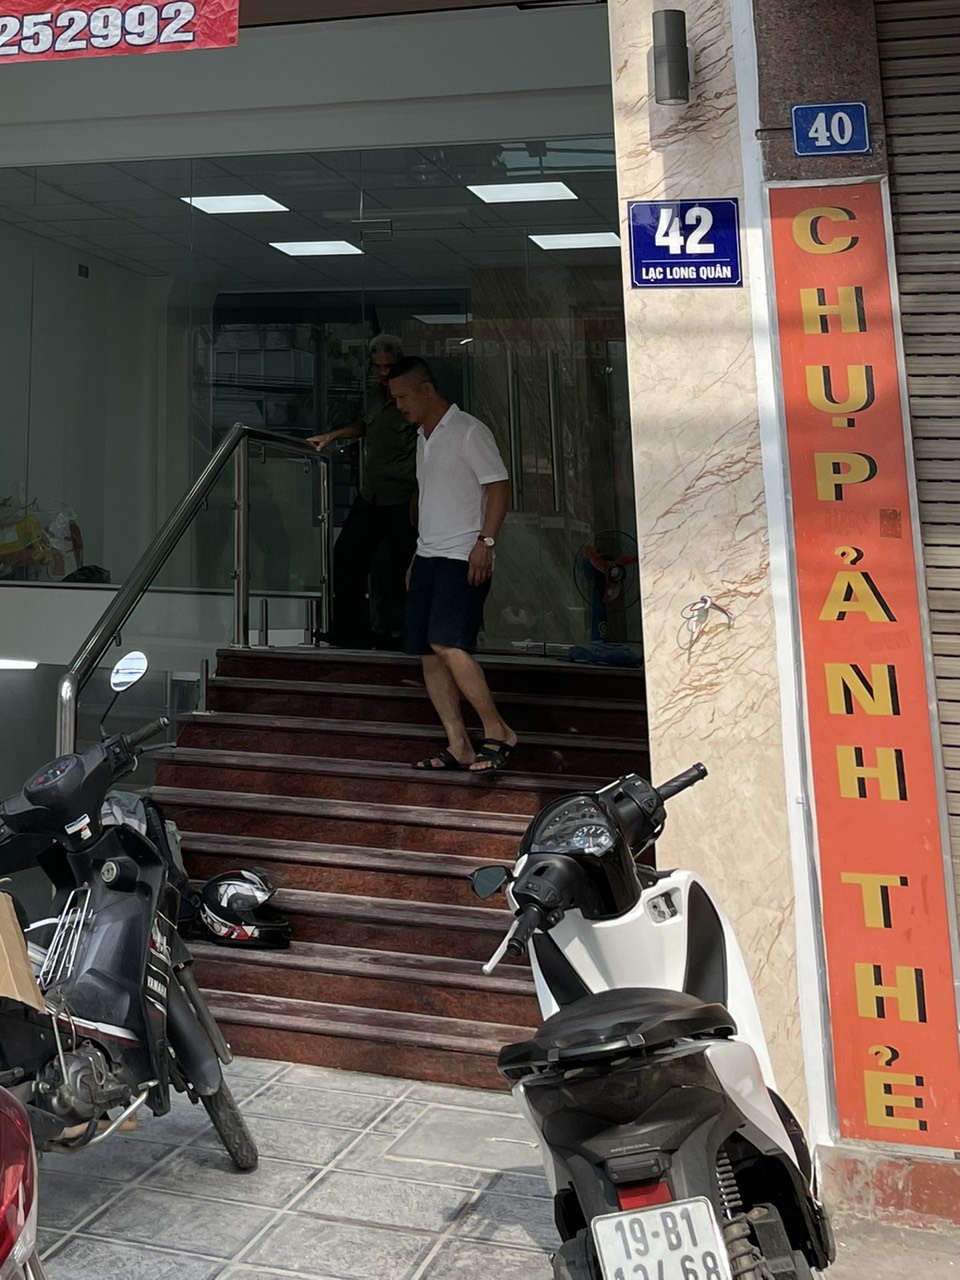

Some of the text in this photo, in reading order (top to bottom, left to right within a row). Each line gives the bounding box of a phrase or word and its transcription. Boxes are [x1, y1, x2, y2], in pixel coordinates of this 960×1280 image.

[807, 111, 853, 147] 40
[642, 263, 732, 282] LẠC LONG QUÂN
[654, 206, 716, 255] 42
[792, 206, 878, 501] CHỤP
[819, 546, 908, 801] ẢNH
[840, 871, 928, 1133] THẺ
